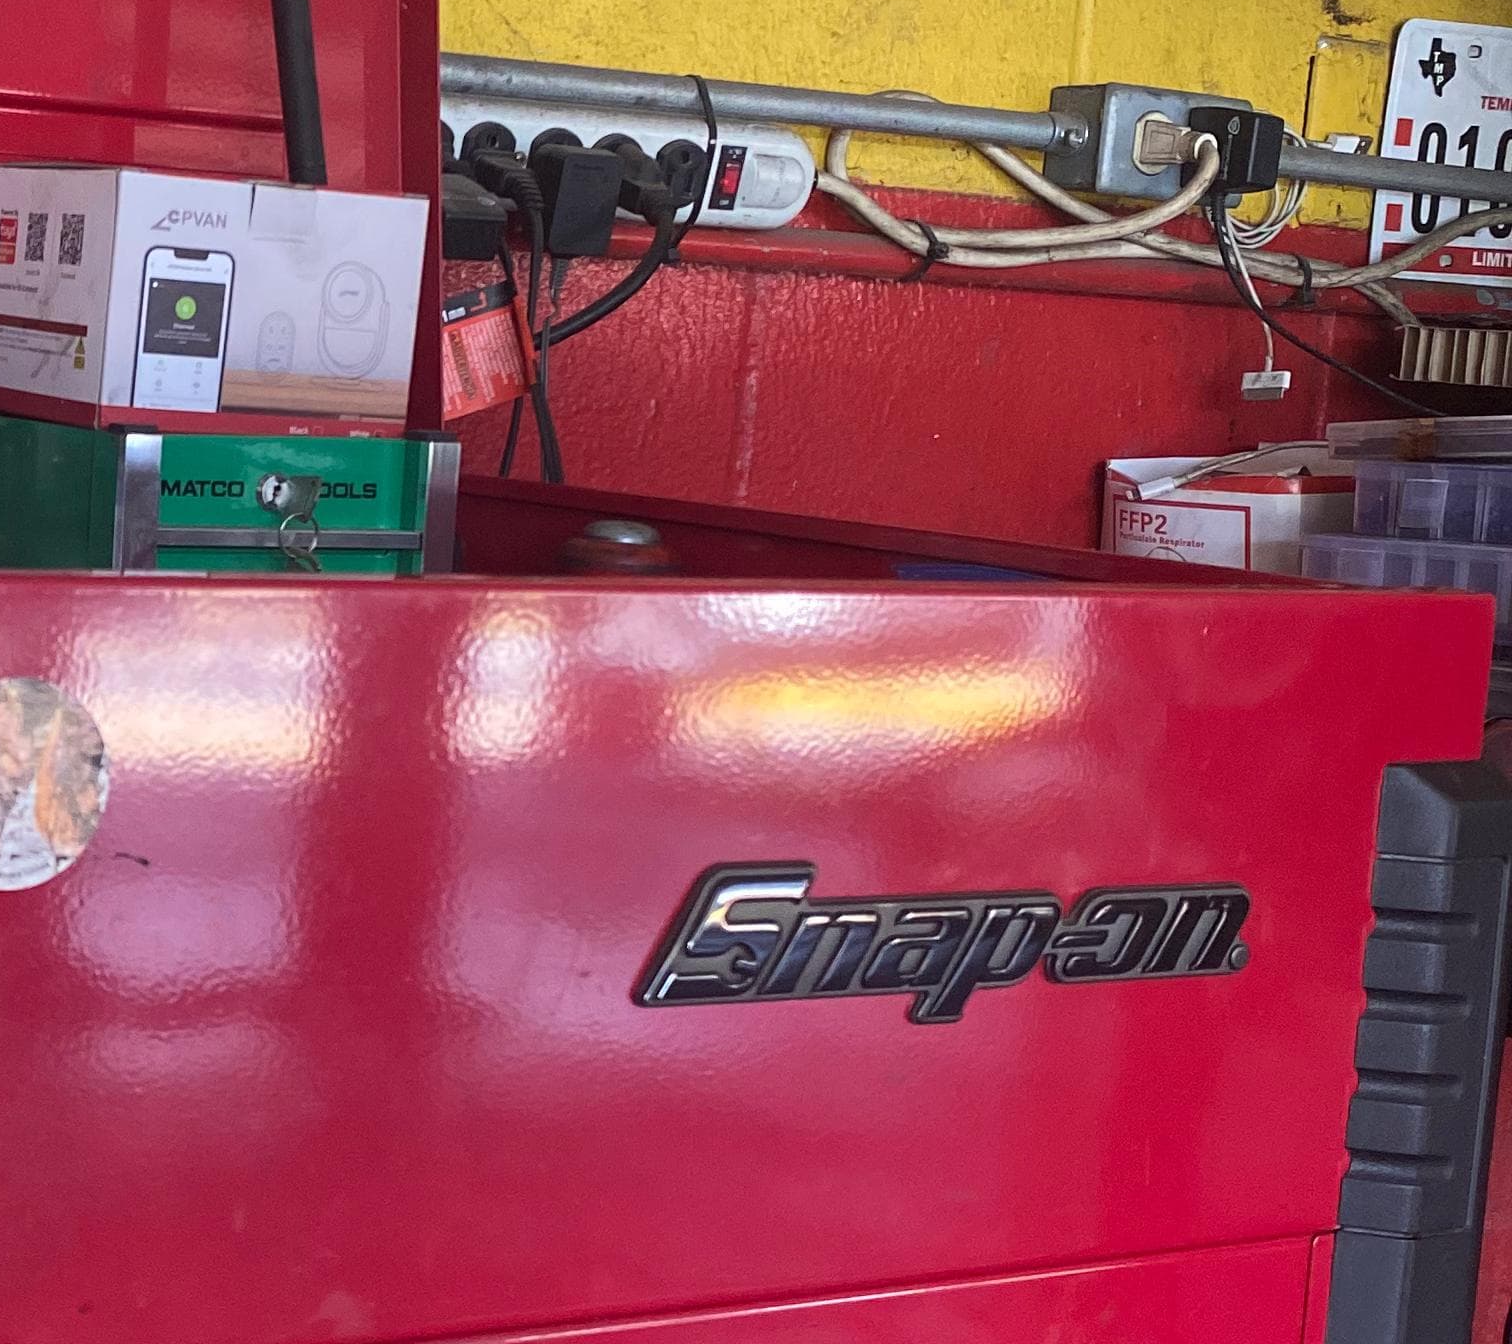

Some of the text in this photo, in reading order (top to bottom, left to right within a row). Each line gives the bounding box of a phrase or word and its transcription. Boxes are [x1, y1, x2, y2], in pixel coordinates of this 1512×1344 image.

[160, 480, 377, 499] MATCO OOLS
[1120, 509, 1167, 534] FFP2
[1160, 536, 1205, 548] Respirator
[631, 863, 1250, 1023] Snap-on
